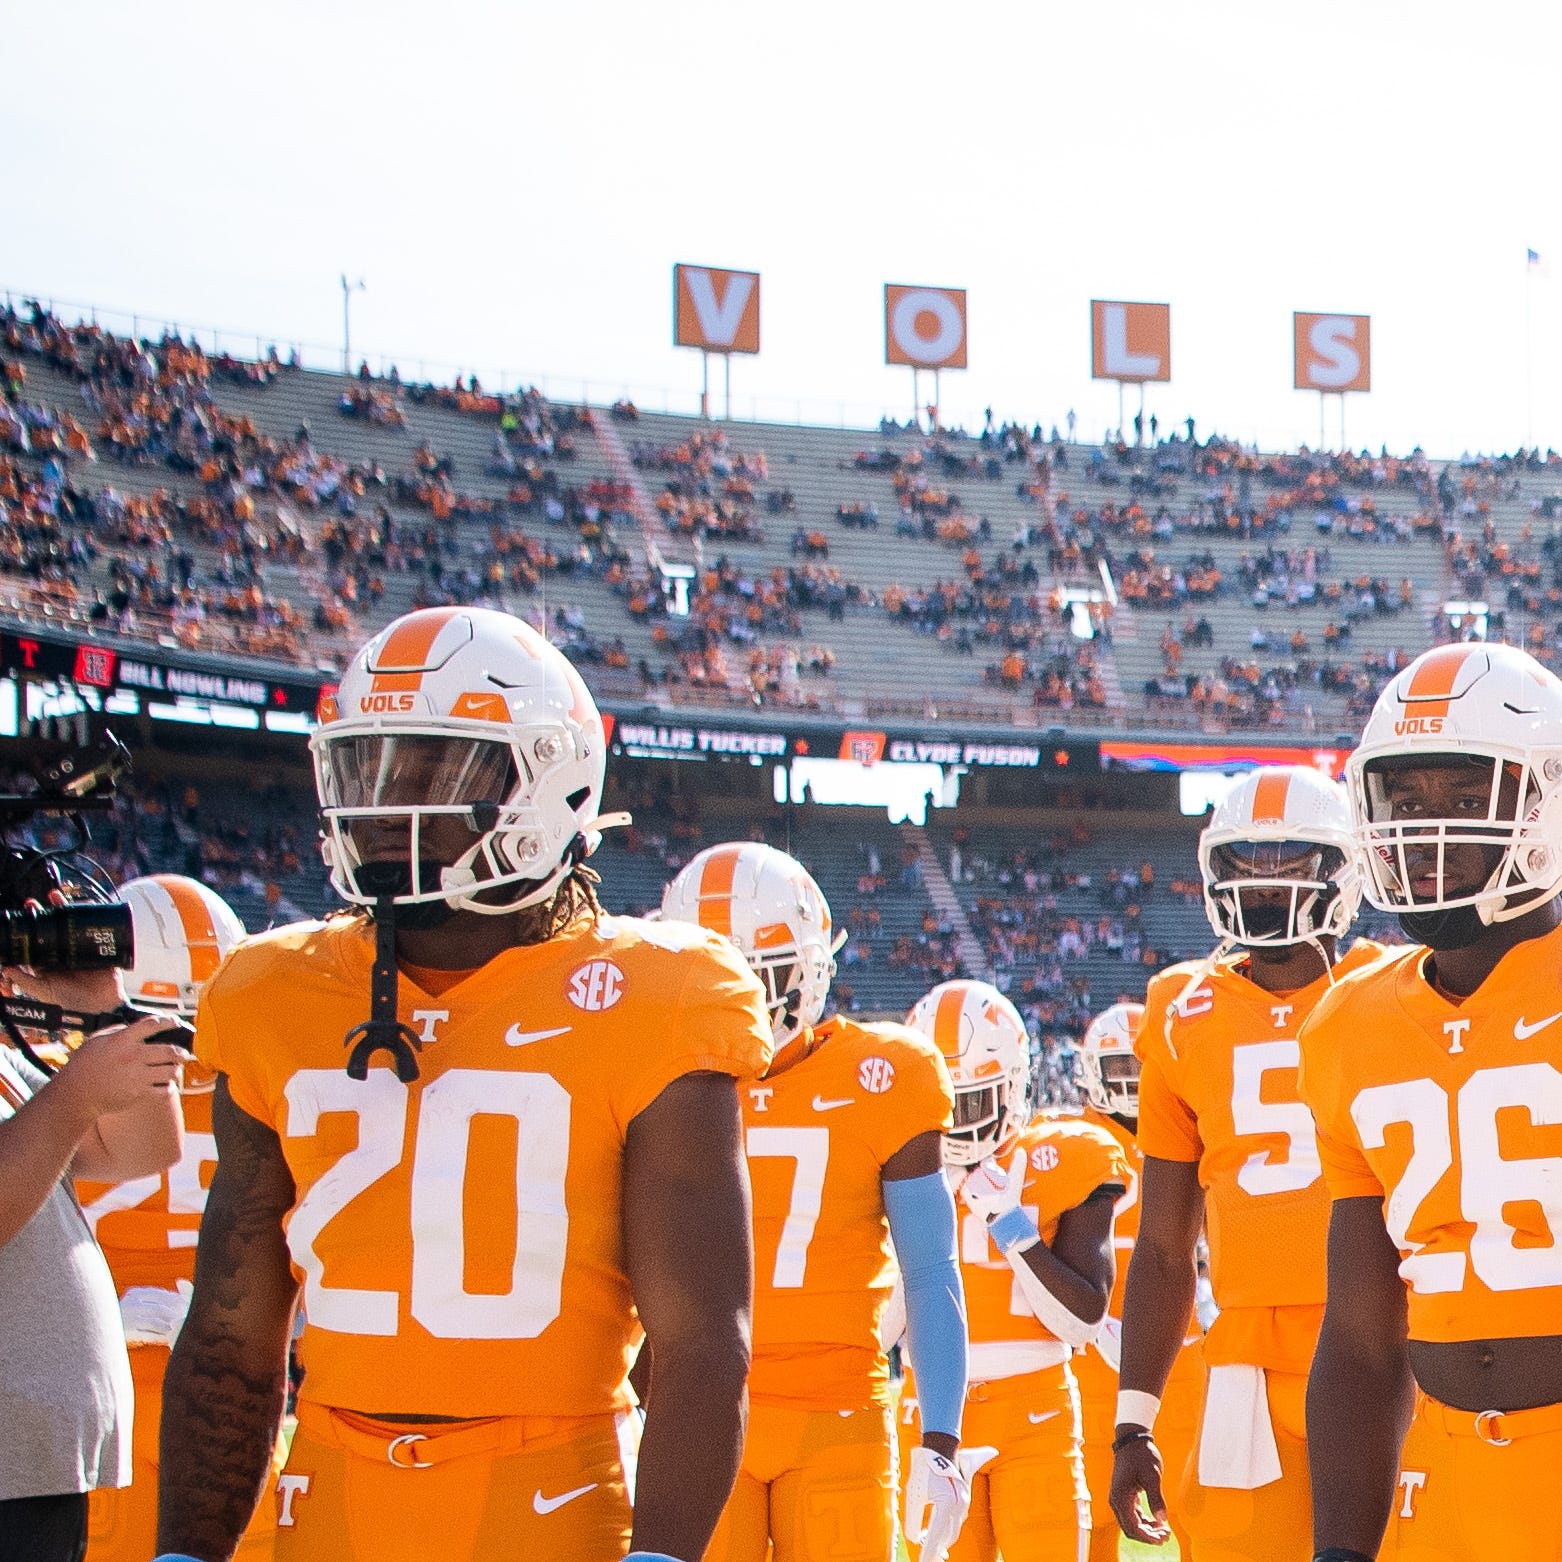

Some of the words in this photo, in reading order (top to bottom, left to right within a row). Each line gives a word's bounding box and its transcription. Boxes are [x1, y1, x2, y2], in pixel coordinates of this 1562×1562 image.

[18, 638, 39, 668] T
[119, 659, 166, 690] BILL
[166, 666, 268, 705] NOWLING
[360, 693, 416, 714] VOLS
[618, 723, 695, 751] WILLIS
[698, 731, 787, 756] TUCKER
[1394, 718, 1444, 736] VOLS
[890, 740, 960, 763] CLYDE
[963, 744, 1041, 768] FUSON
[567, 960, 625, 1012] SEC
[1176, 987, 1214, 1019] C
[411, 1008, 450, 1043] T
[1270, 1005, 1294, 1028] T
[1442, 1019, 1471, 1054] T
[857, 1055, 896, 1093] SEC
[748, 1088, 774, 1113] T
[1230, 1039, 1323, 1197] 5
[1030, 1144, 1060, 1171] SEC
[283, 1066, 572, 1339] 20
[746, 1126, 830, 1289] 7
[277, 1473, 310, 1527] T
[1399, 1470, 1427, 1520] T
